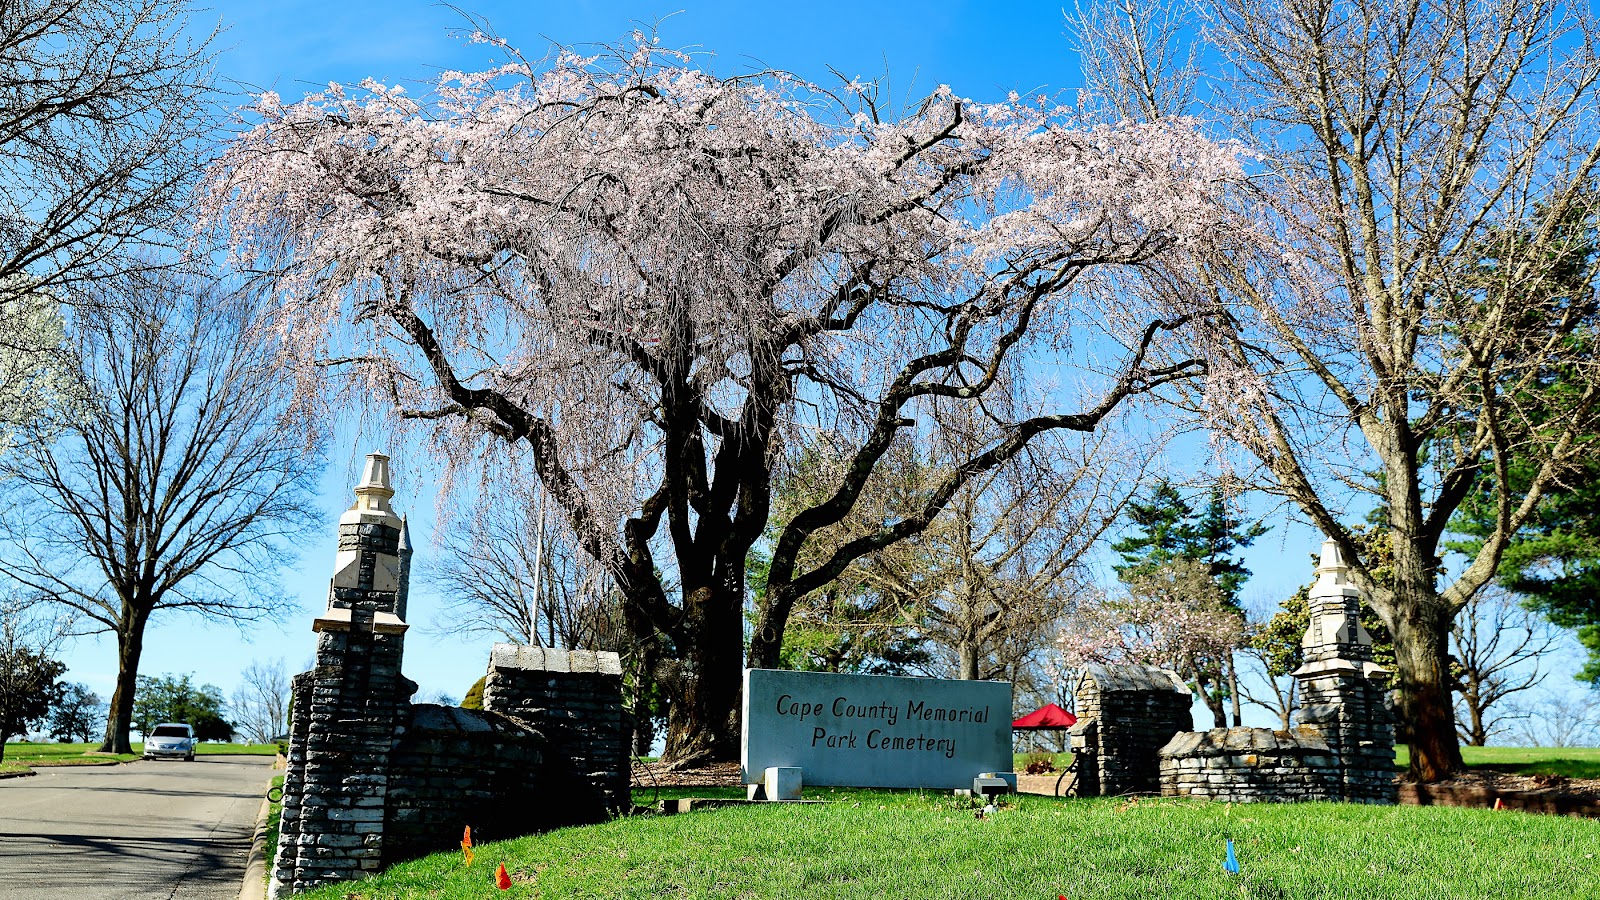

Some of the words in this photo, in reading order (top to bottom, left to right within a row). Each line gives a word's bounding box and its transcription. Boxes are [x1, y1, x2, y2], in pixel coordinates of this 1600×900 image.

[776, 694, 824, 721] Cape
[832, 696, 898, 725] County
[906, 700, 989, 723] Memorial
[811, 727, 857, 749] Park
[866, 729, 956, 758] Cemetery
